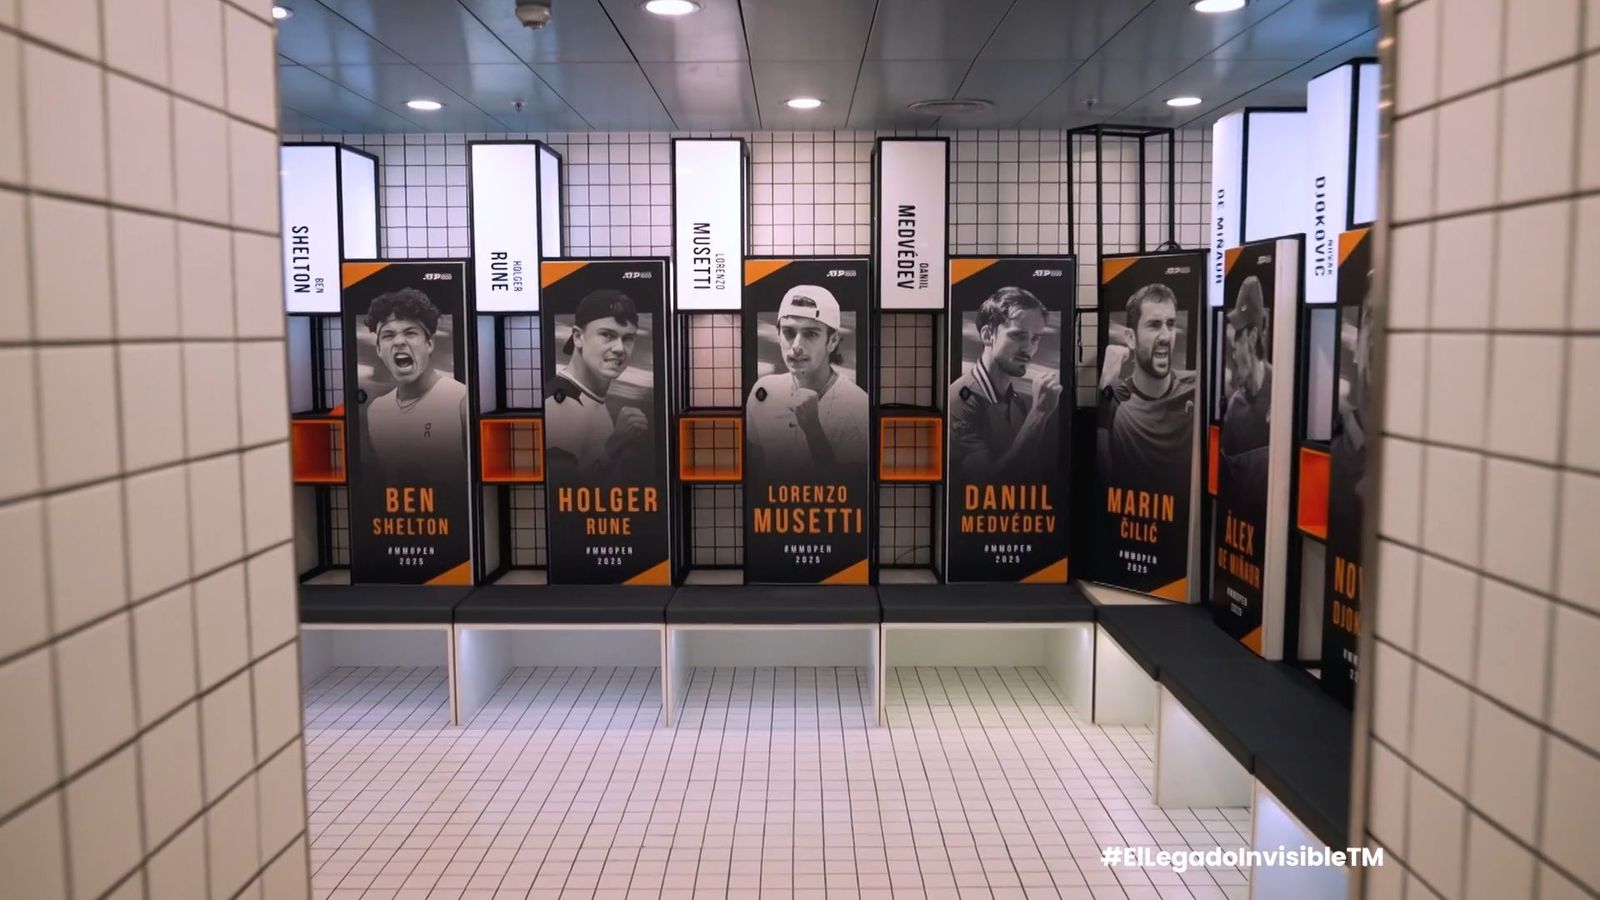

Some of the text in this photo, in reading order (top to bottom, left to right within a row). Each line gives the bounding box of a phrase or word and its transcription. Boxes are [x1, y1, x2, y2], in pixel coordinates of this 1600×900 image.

[693, 223, 711, 289] MUSETTI
[897, 205, 918, 289] MEDVÉDEV
[292, 225, 311, 293] SHELTON
[491, 252, 508, 291] RUNE
[512, 260, 523, 292] HOLGER
[715, 253, 725, 290] LORENZO
[919, 262, 929, 289] DANIIL
[315, 277, 325, 294] BEN
[386, 487, 434, 512] BEN
[558, 487, 658, 512] HOLGER
[768, 485, 847, 503] LORENZO
[965, 485, 1053, 510] DANIIL
[1107, 487, 1175, 522] MARIN
[372, 518, 448, 535] SHELTON
[586, 518, 631, 535] RUNE
[753, 508, 862, 533] MUSETTI
[961, 512, 1055, 533] MEDVÉDEV
[1121, 517, 1158, 544] ČILIĆ
[388, 546, 434, 555] #MMOPEN
[586, 546, 633, 555] #MMOPEN
[784, 545, 832, 553] #MMOPEN
[795, 555, 821, 564] 2025
[984, 544, 1032, 552] #MMOPEN
[995, 555, 1020, 563] 2025
[399, 558, 424, 566] 2025
[597, 557, 622, 565] 2025
